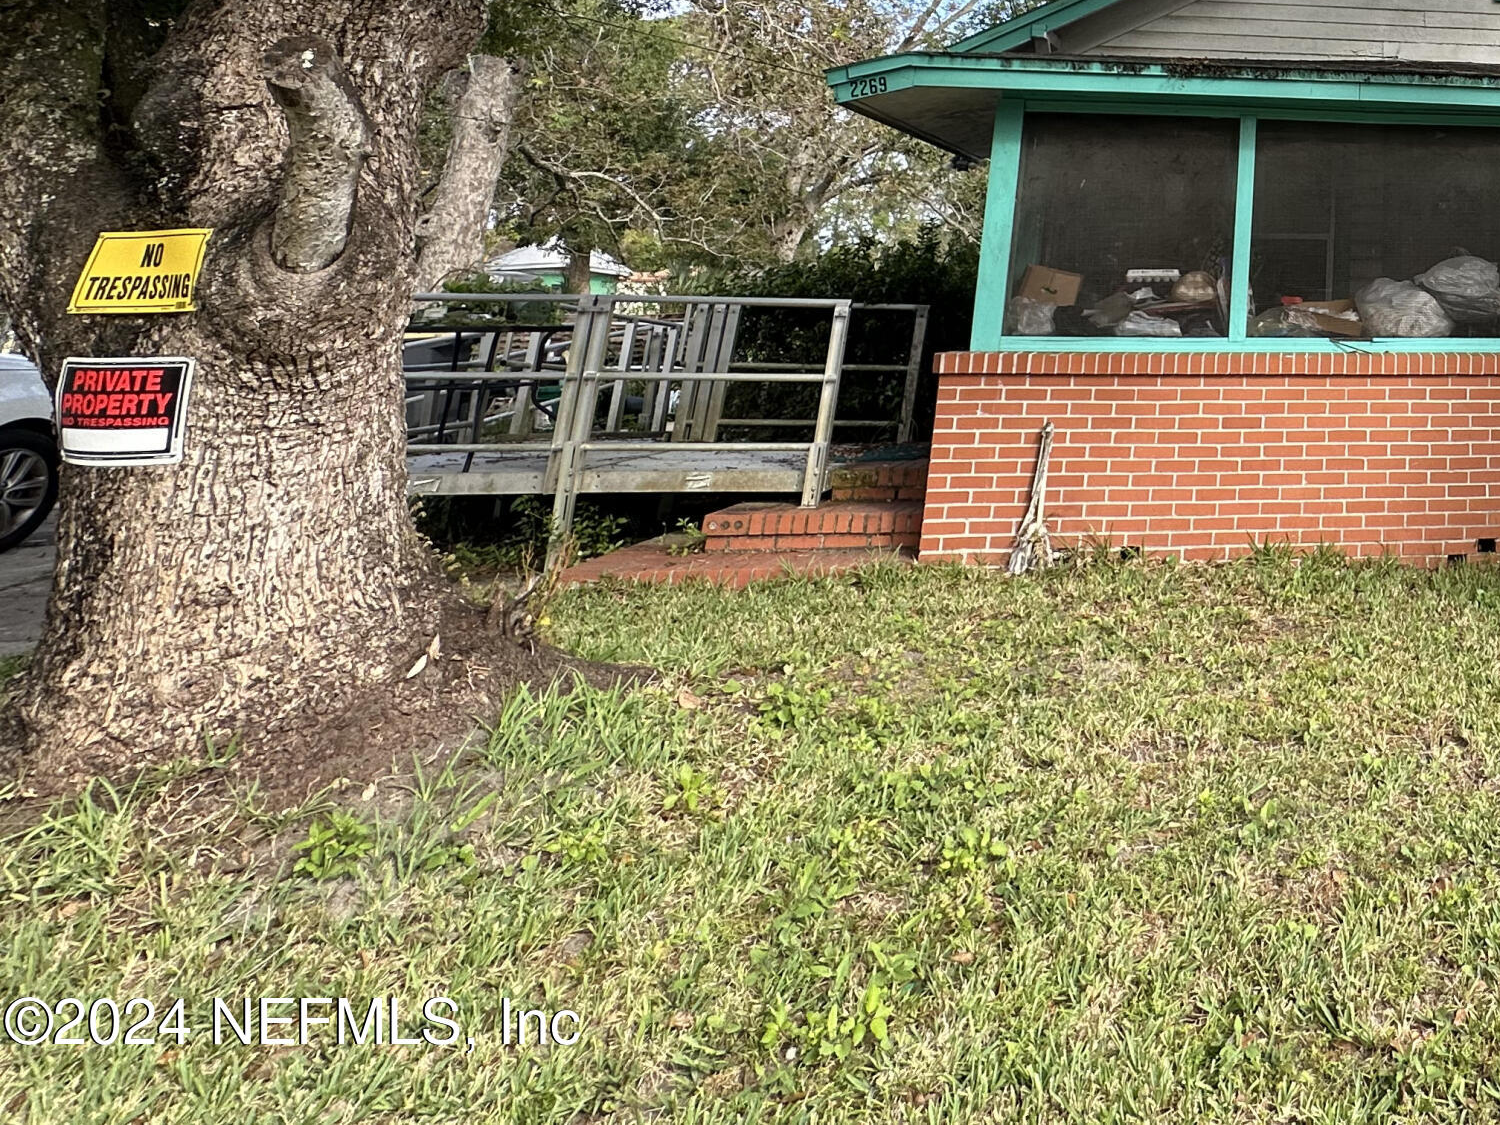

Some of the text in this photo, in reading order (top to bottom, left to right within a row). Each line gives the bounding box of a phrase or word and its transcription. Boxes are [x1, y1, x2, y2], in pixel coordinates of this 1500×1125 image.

[850, 76, 888, 98] 2269
[140, 243, 164, 268] NO
[84, 274, 190, 301] TRESPASSING
[72, 369, 164, 392] PRIVATE
[62, 393, 173, 415] PROPERTY
[77, 416, 170, 427] TRESPASSING
